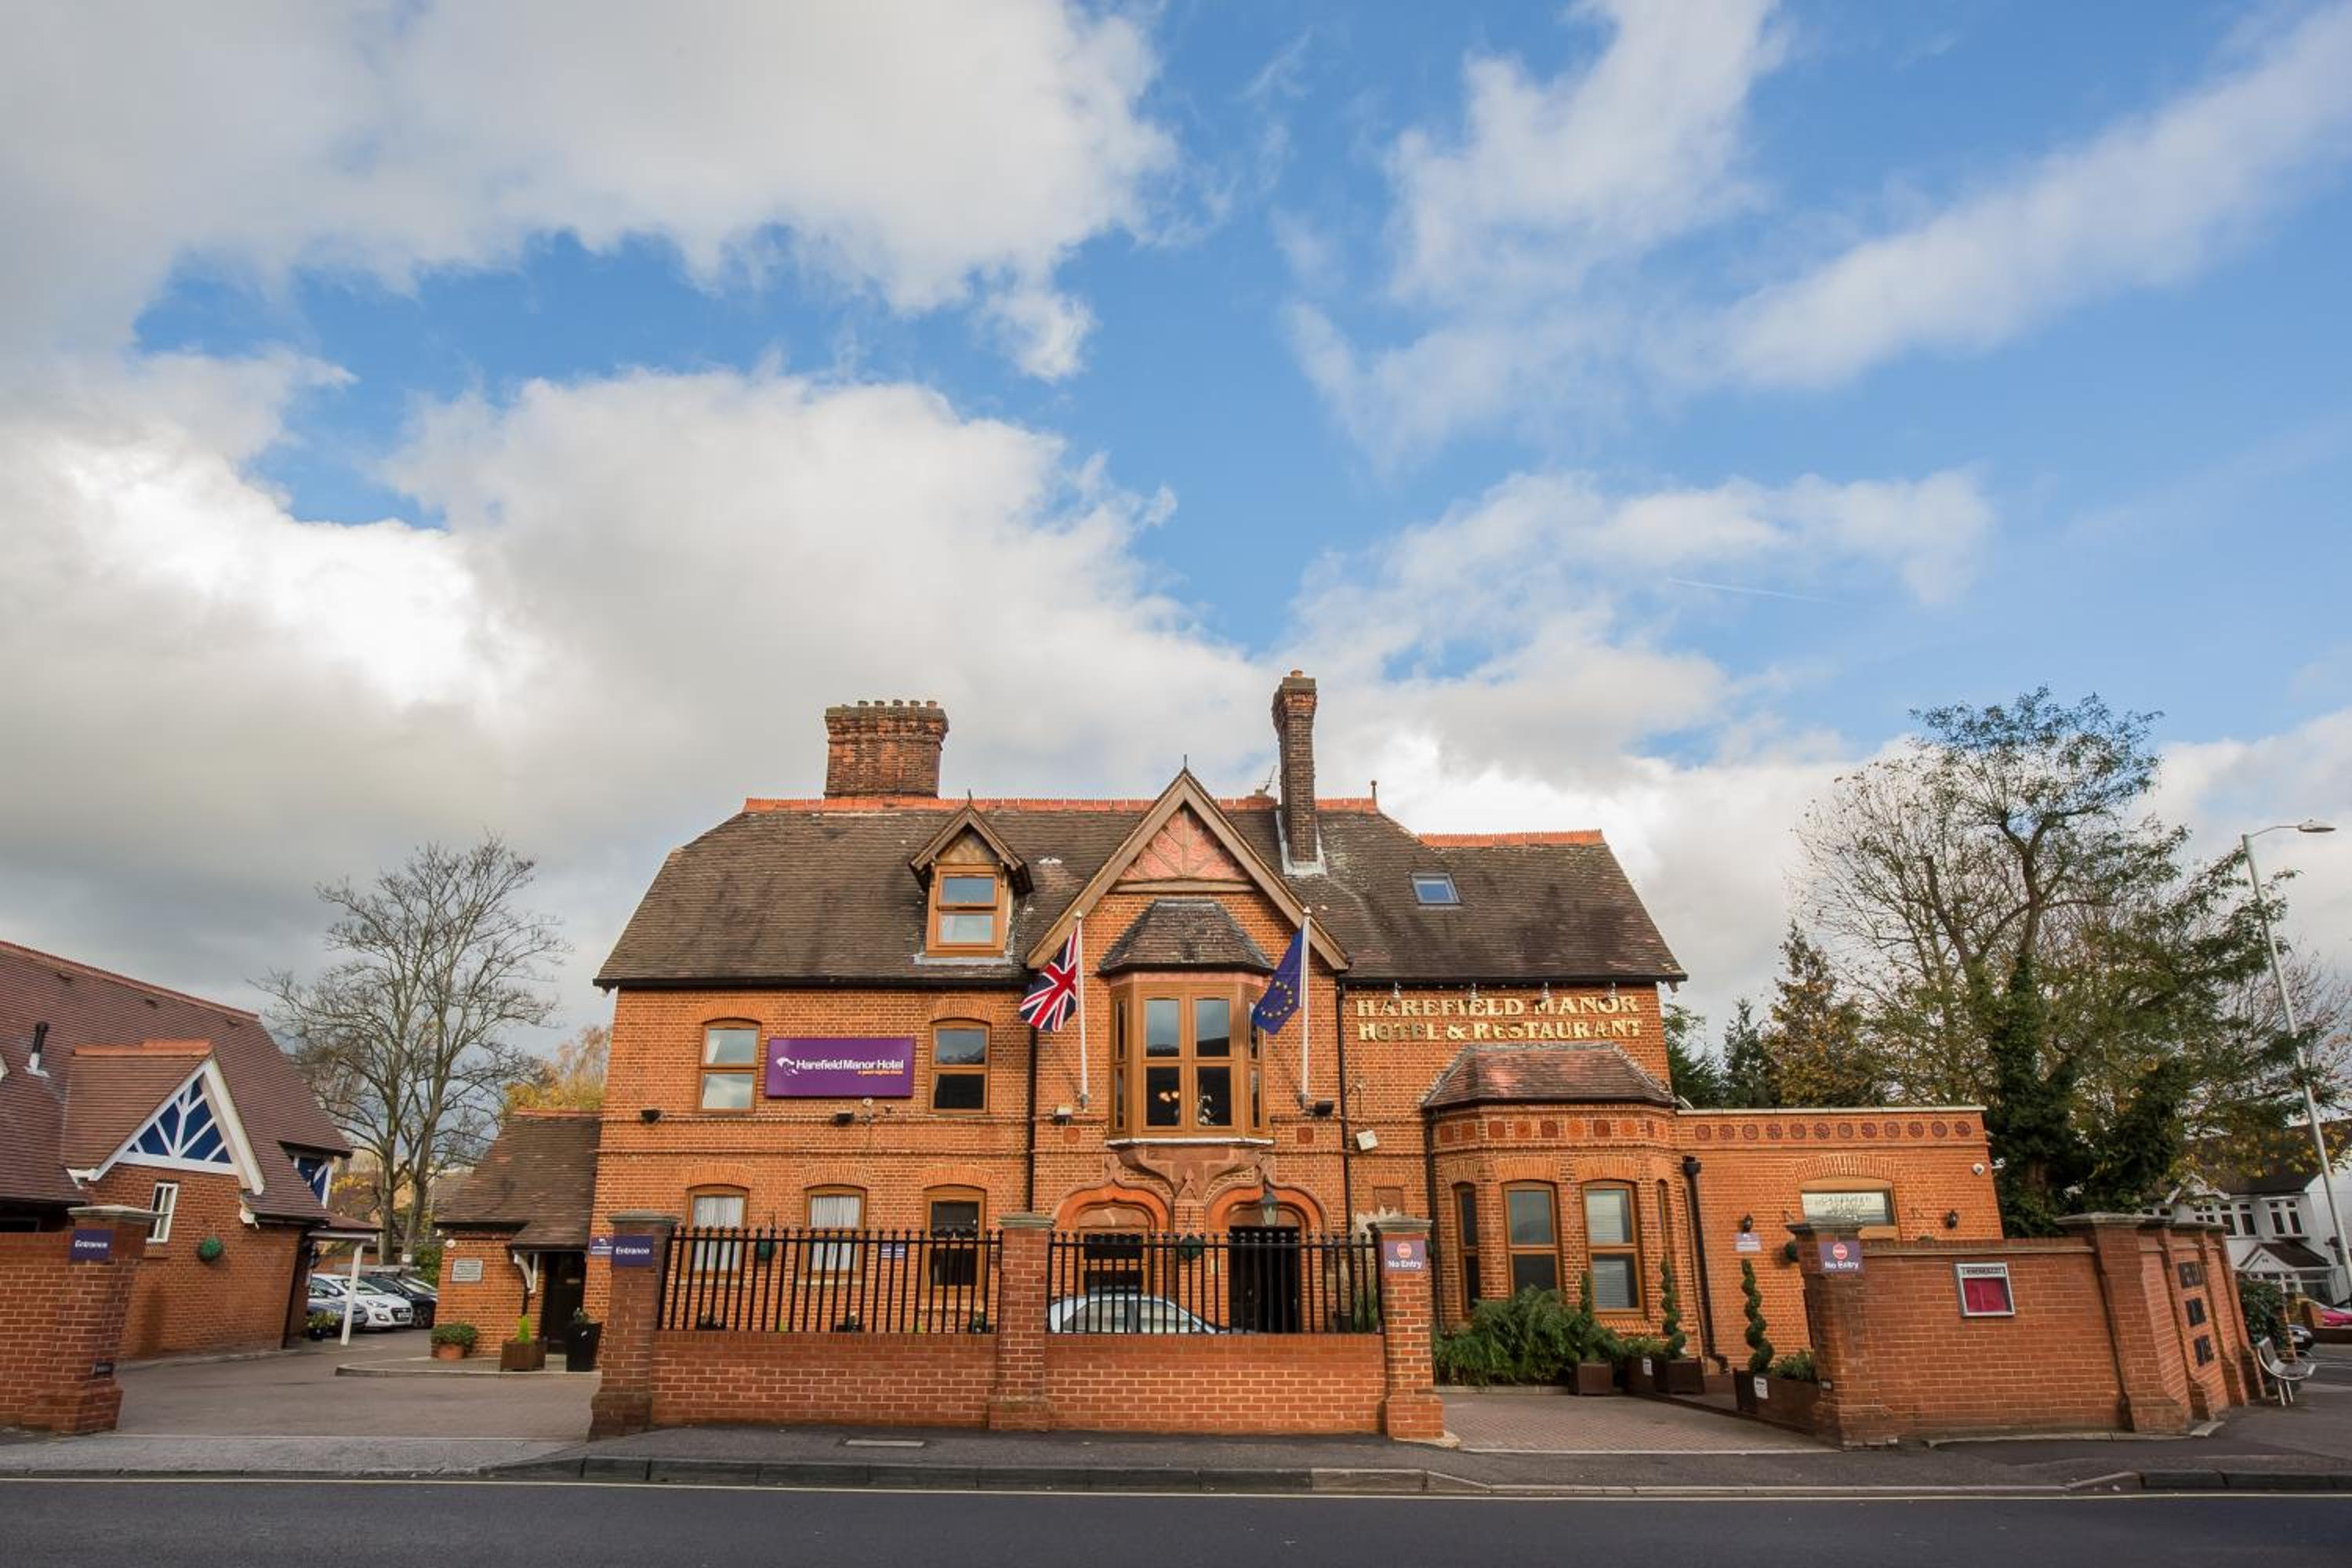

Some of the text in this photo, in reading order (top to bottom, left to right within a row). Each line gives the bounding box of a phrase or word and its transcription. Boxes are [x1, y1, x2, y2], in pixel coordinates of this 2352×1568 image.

[1356, 995, 1640, 1018] HAREFIELD MANOR
[1358, 1019, 1642, 1042] HOTEL & RESTAURANT
[796, 1059, 904, 1070] Harefield Manor Hotel
[74, 1240, 108, 1249] Entrance
[615, 1246, 650, 1255] Entrance
[1401, 1259, 1422, 1269] Entry
[1824, 1260, 1859, 1269] No Entry
